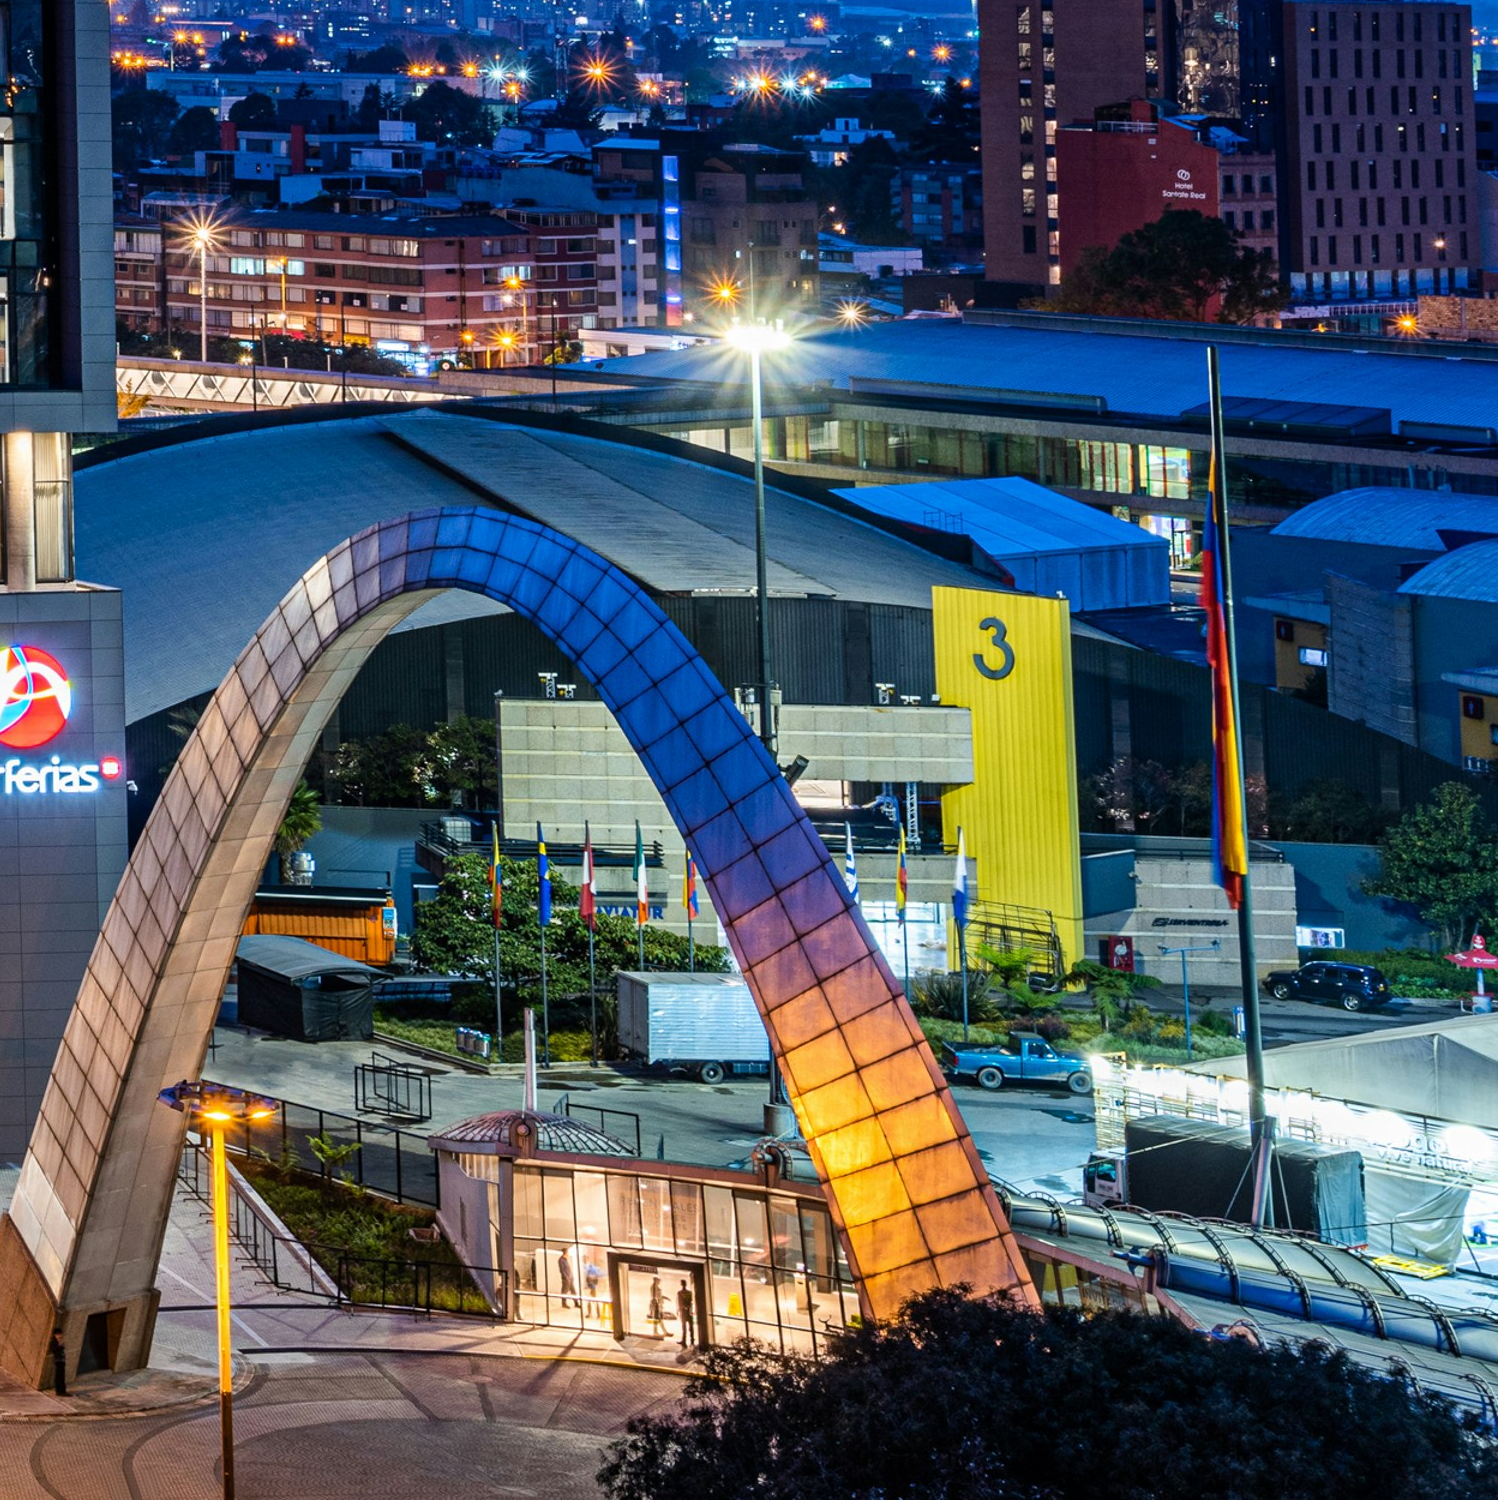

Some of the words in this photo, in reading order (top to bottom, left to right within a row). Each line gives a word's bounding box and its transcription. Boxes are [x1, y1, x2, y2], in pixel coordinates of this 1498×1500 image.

[1174, 182, 1193, 190] Hotel
[972, 617, 1015, 680] 3
[596, 905, 664, 919] AVIATR
